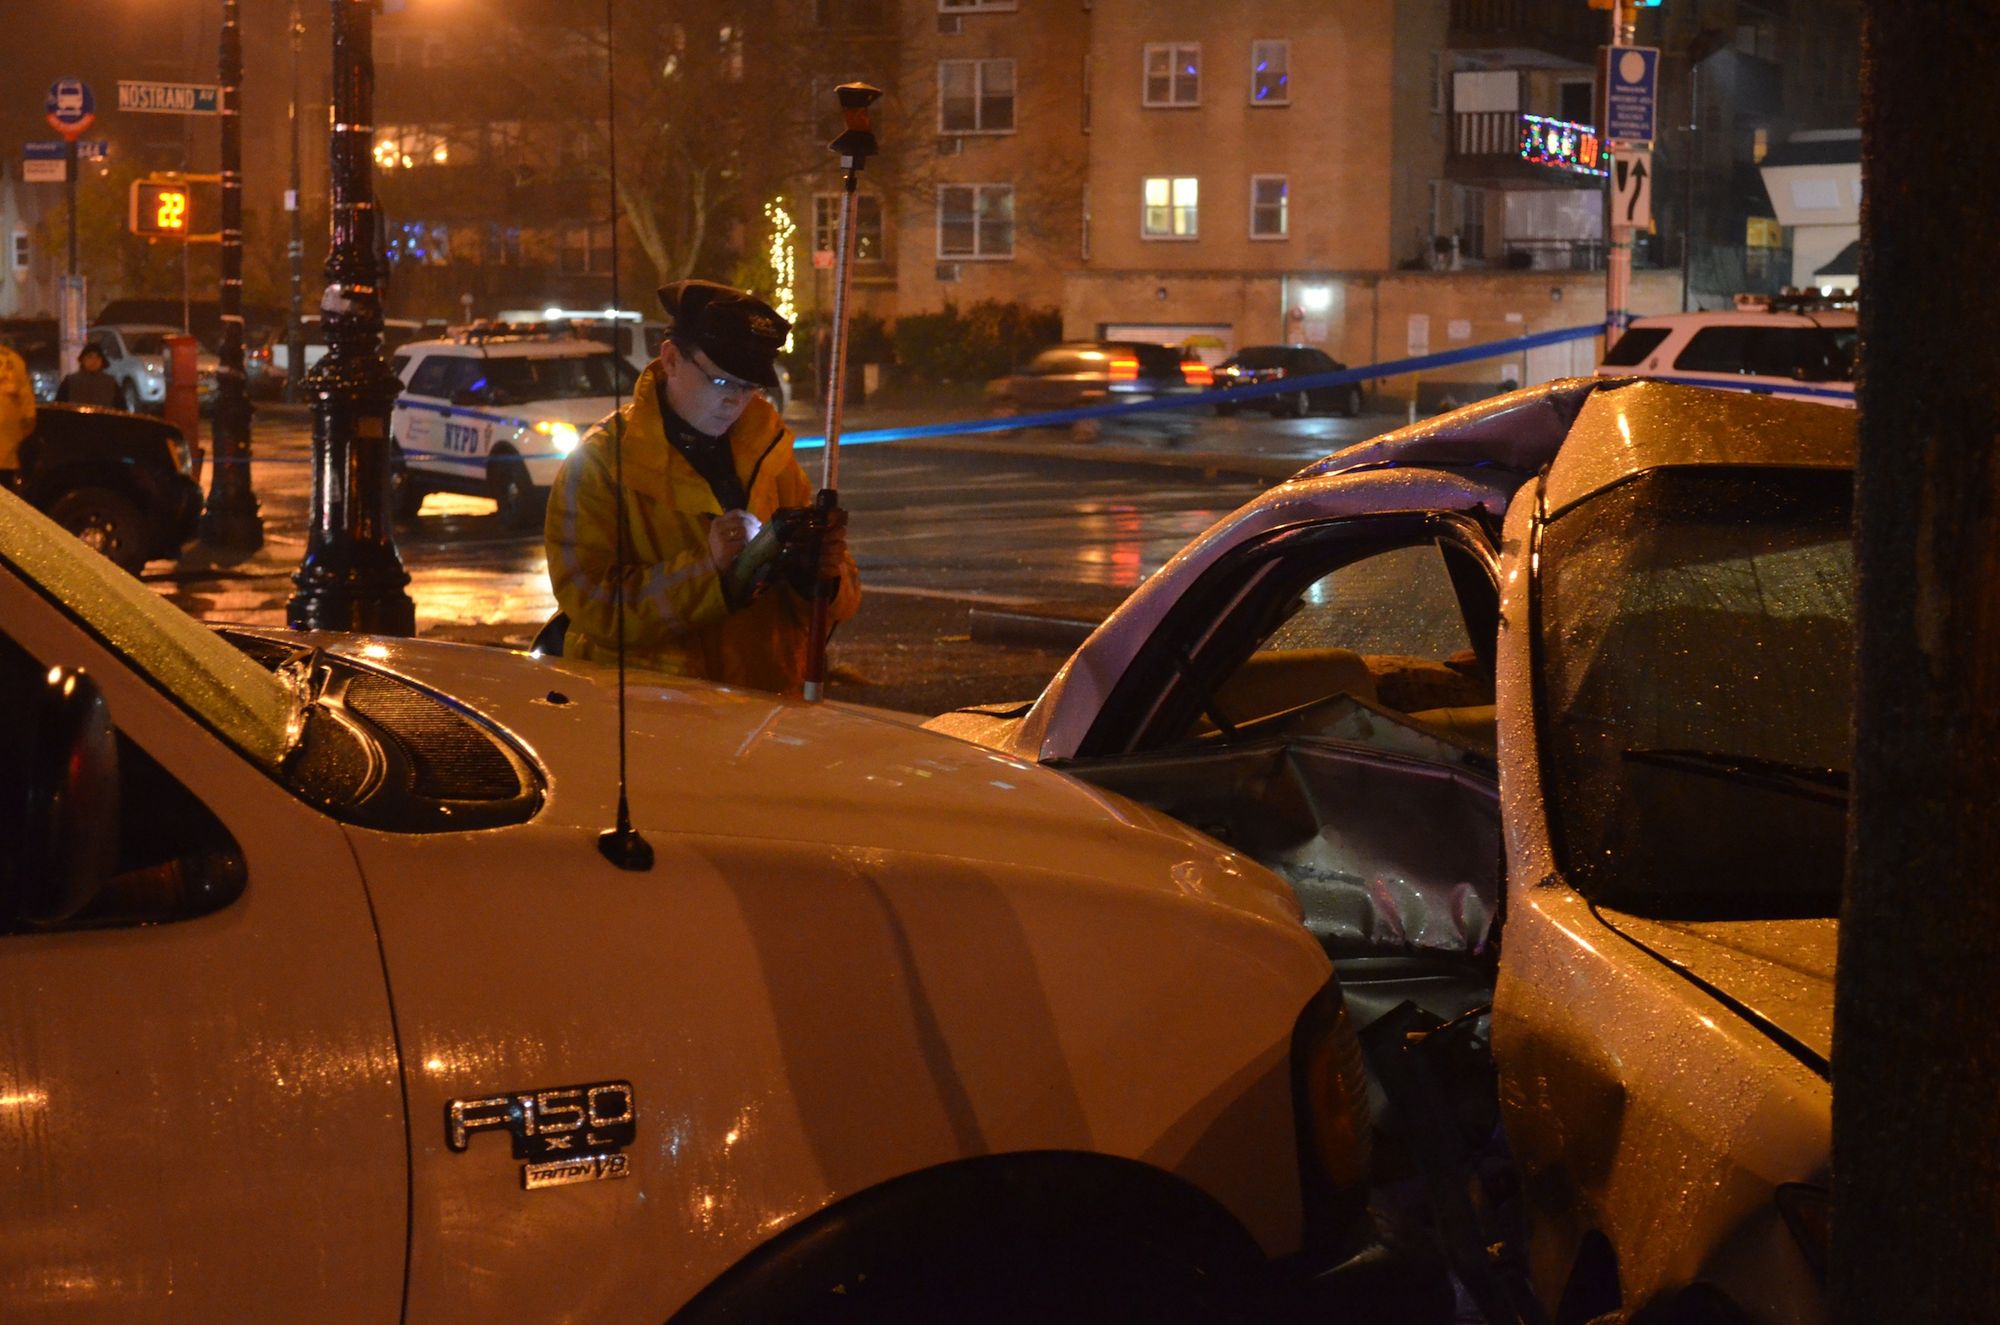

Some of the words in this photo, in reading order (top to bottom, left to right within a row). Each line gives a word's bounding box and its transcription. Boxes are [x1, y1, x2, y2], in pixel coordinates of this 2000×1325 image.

[119, 84, 195, 111] NOSTRAND
[445, 424, 479, 454] NYPD
[530, 1164, 591, 1181] TRITON
[594, 1156, 626, 1179] V8
